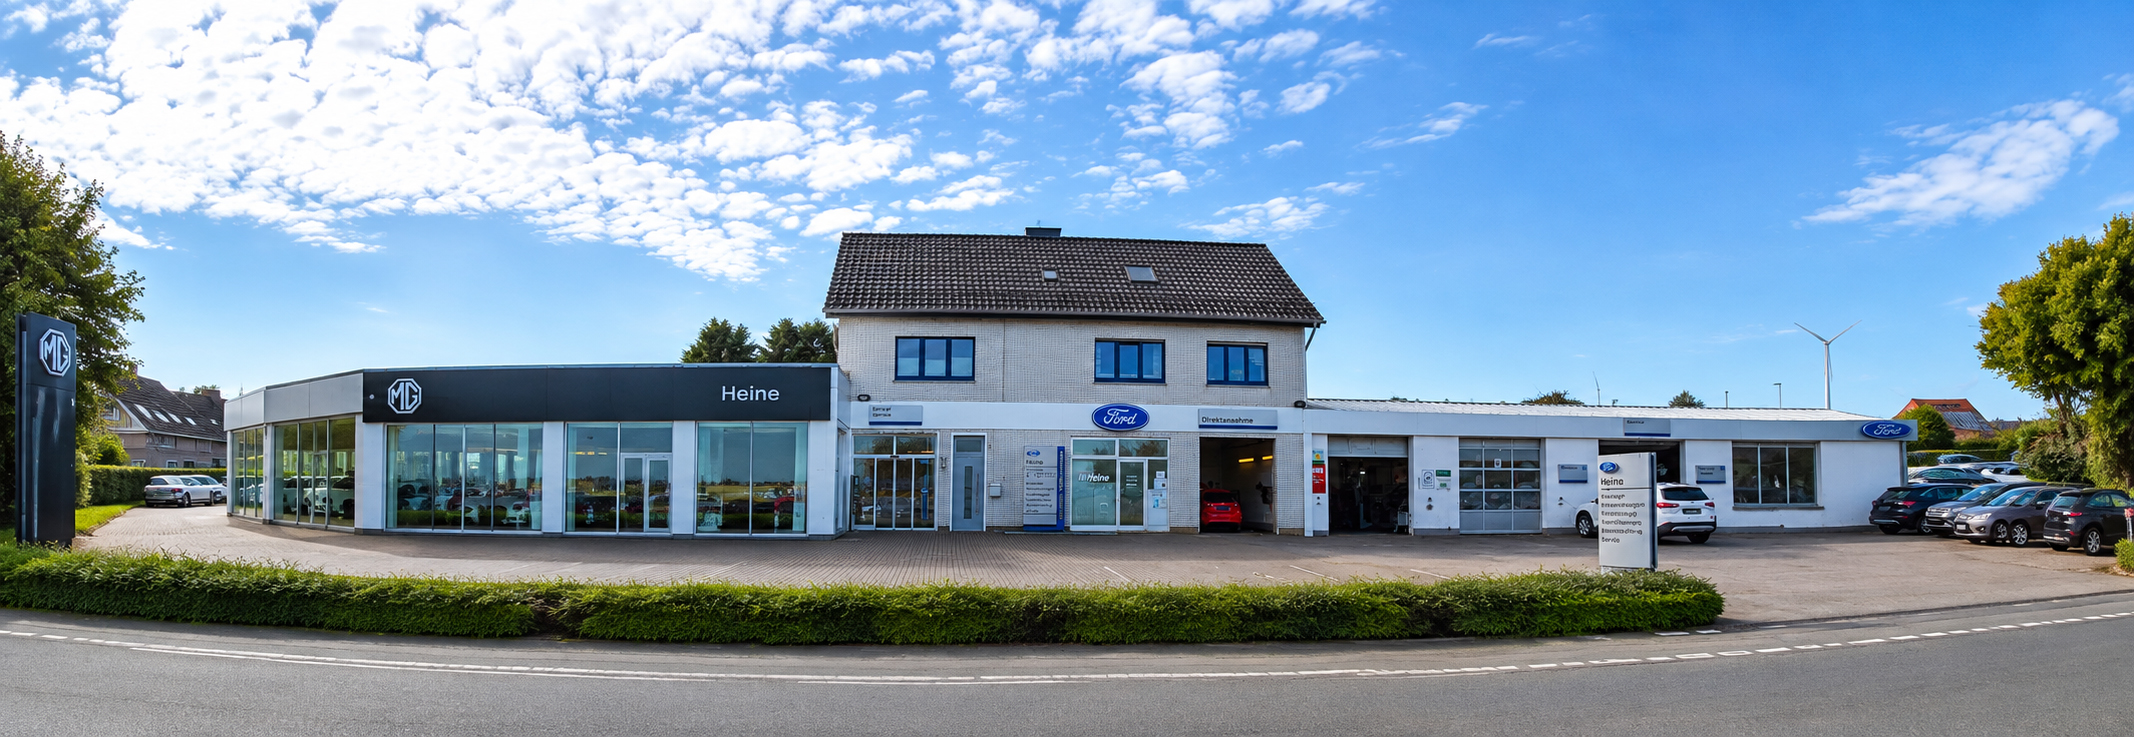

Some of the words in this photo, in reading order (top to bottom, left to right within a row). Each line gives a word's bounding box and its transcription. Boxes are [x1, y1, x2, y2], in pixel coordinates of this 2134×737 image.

[44, 334, 68, 372] MG
[391, 382, 418, 410] MG
[722, 385, 780, 401] Heine
[1103, 408, 1138, 425] Ford
[1873, 423, 1902, 436] Ford
